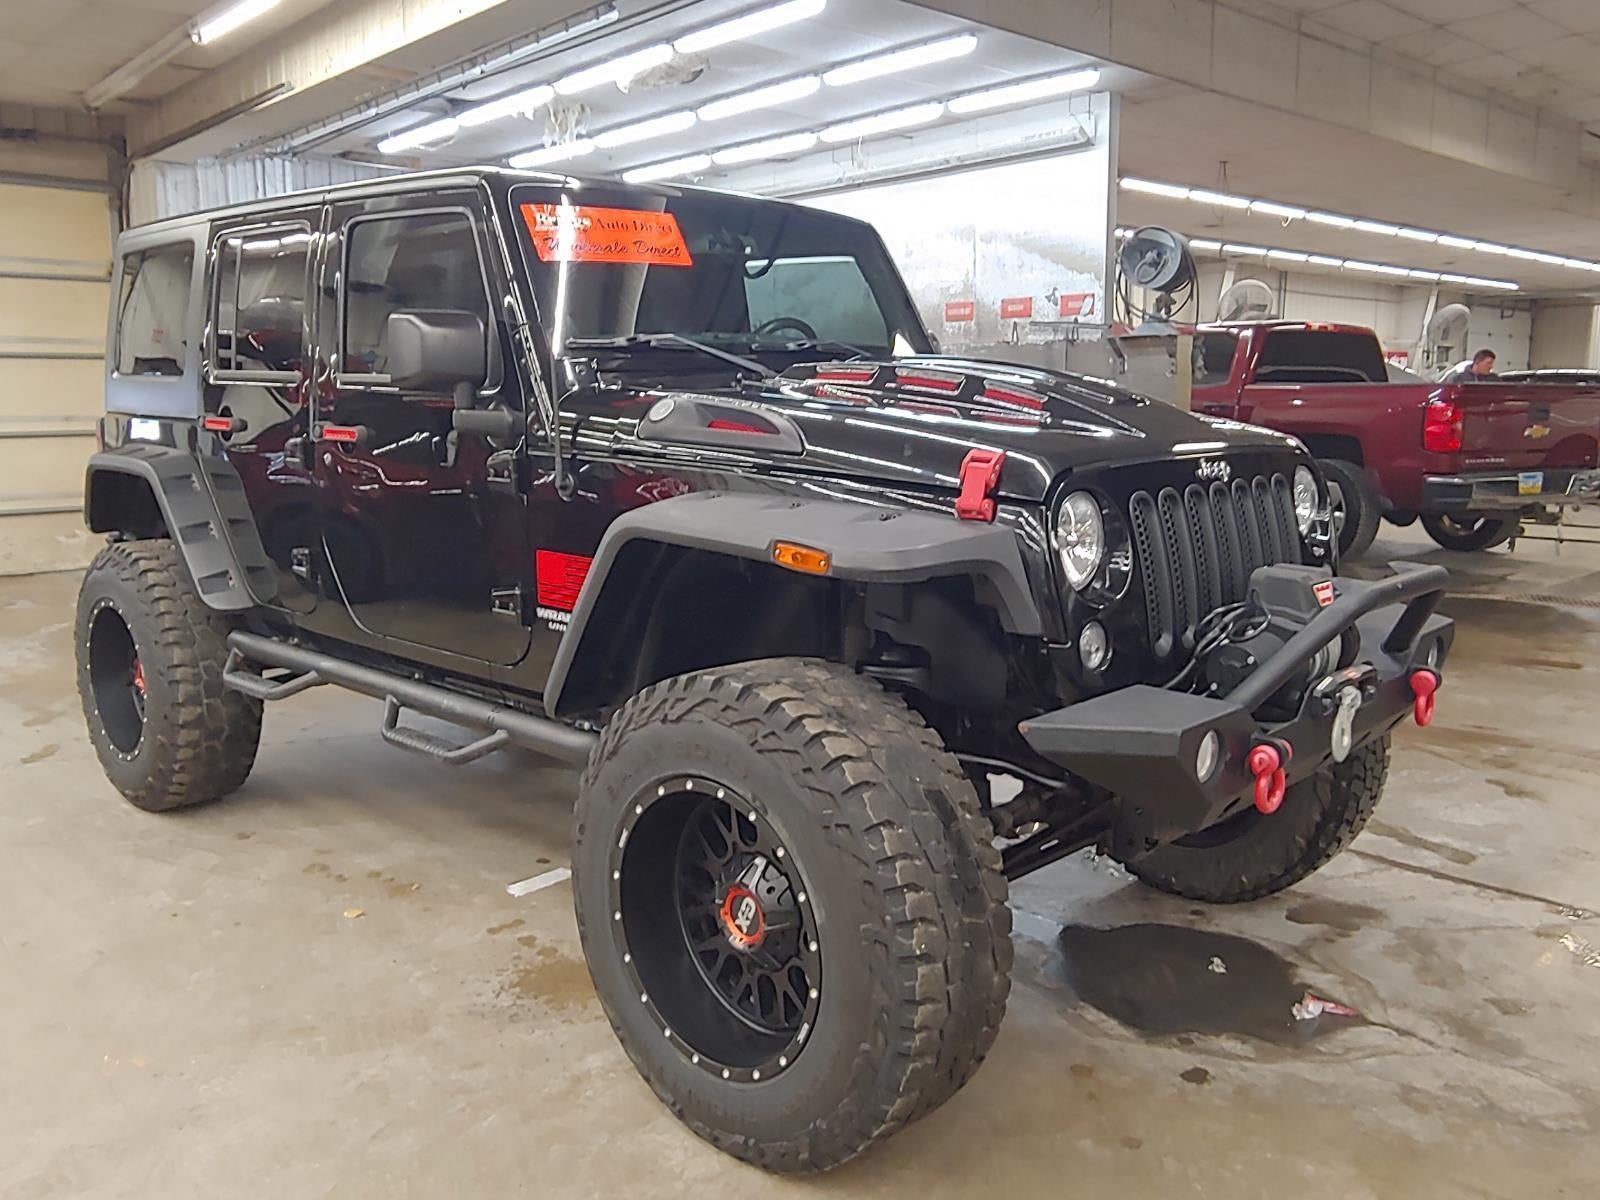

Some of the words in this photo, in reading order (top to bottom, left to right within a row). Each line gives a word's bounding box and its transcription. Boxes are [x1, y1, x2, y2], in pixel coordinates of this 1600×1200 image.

[595, 218, 628, 231] Auto
[542, 237, 629, 254] Wolesale
[1195, 458, 1231, 482] Jeep
